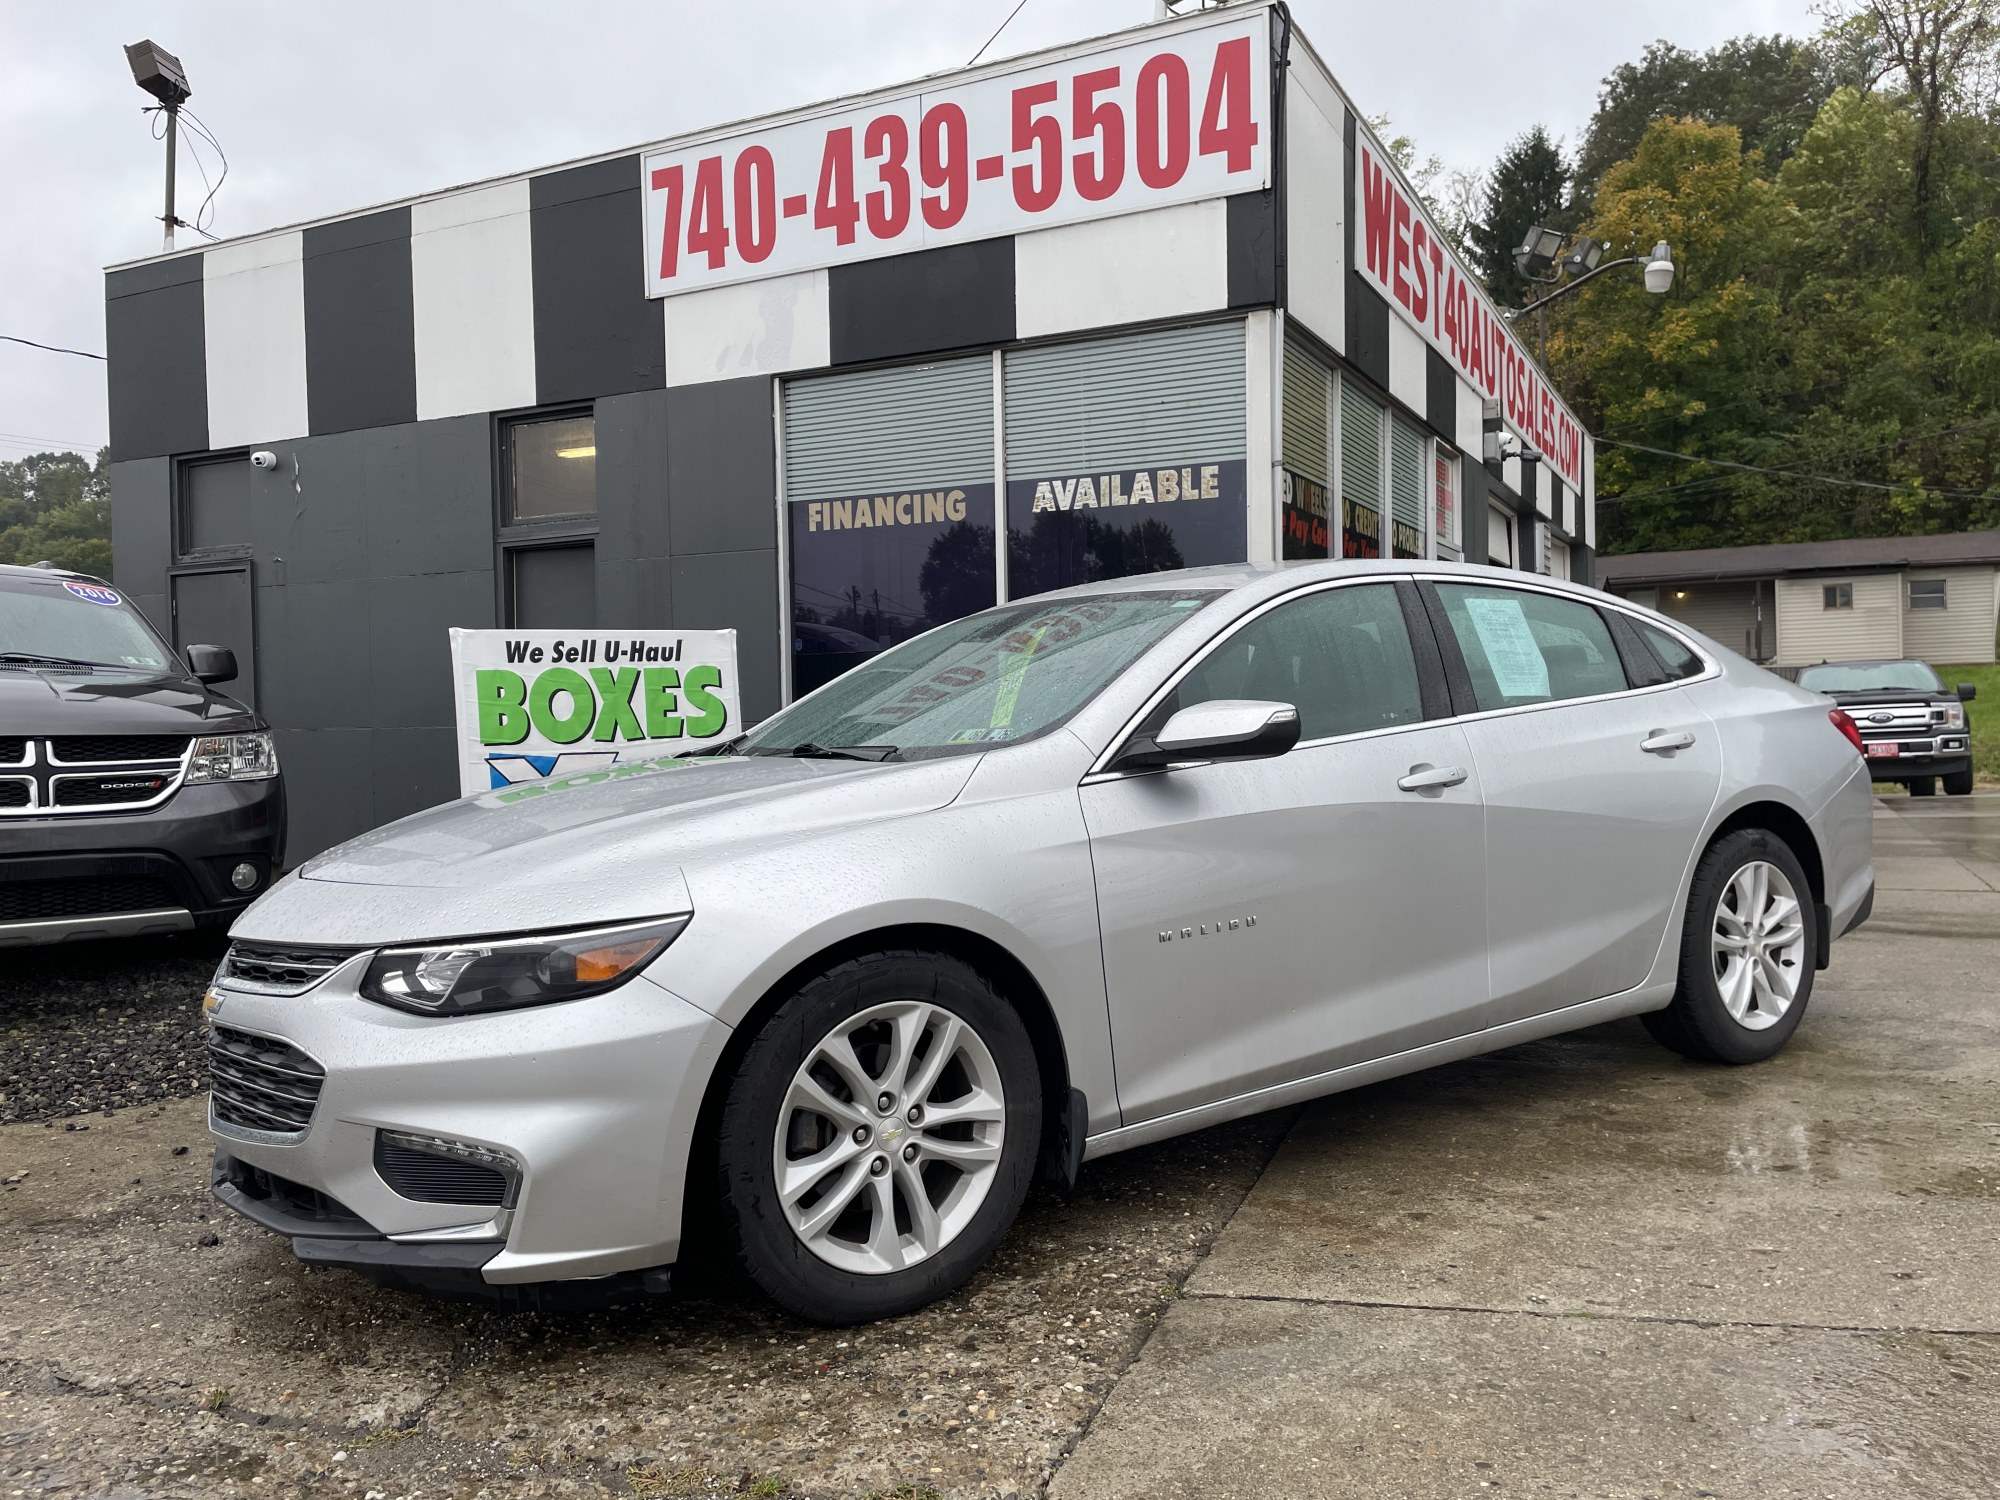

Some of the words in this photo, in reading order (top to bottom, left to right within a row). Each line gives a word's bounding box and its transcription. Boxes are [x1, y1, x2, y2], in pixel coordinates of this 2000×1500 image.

[651, 36, 1259, 280] 740-439-5504
[1031, 465, 1219, 513] AVAILABLE
[808, 489, 967, 532] FINANCING
[1289, 509, 1309, 546] Pay
[73, 586, 117, 602] 2016
[505, 640, 544, 663] We
[551, 639, 597, 663] Sell
[604, 639, 683, 662] U-Haul
[476, 665, 728, 746] BOXES
[101, 781, 154, 789] DODGE
[1159, 915, 1257, 943] MALIBU
